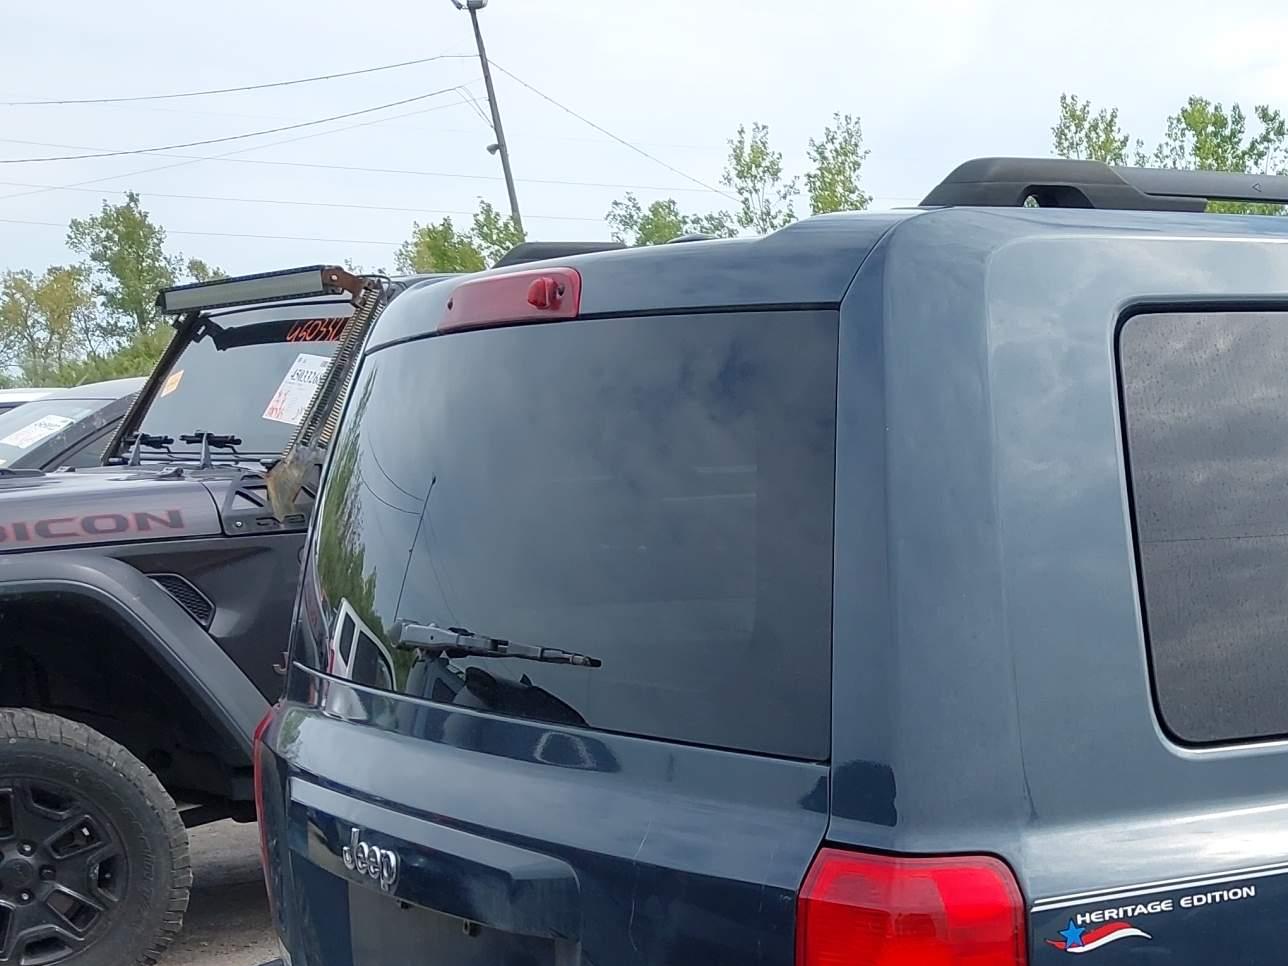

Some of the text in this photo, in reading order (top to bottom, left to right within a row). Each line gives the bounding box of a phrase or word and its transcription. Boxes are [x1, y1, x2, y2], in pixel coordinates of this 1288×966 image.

[342, 827, 398, 893] Jeep
[1077, 886, 1256, 925] HERITAGE EDITION
